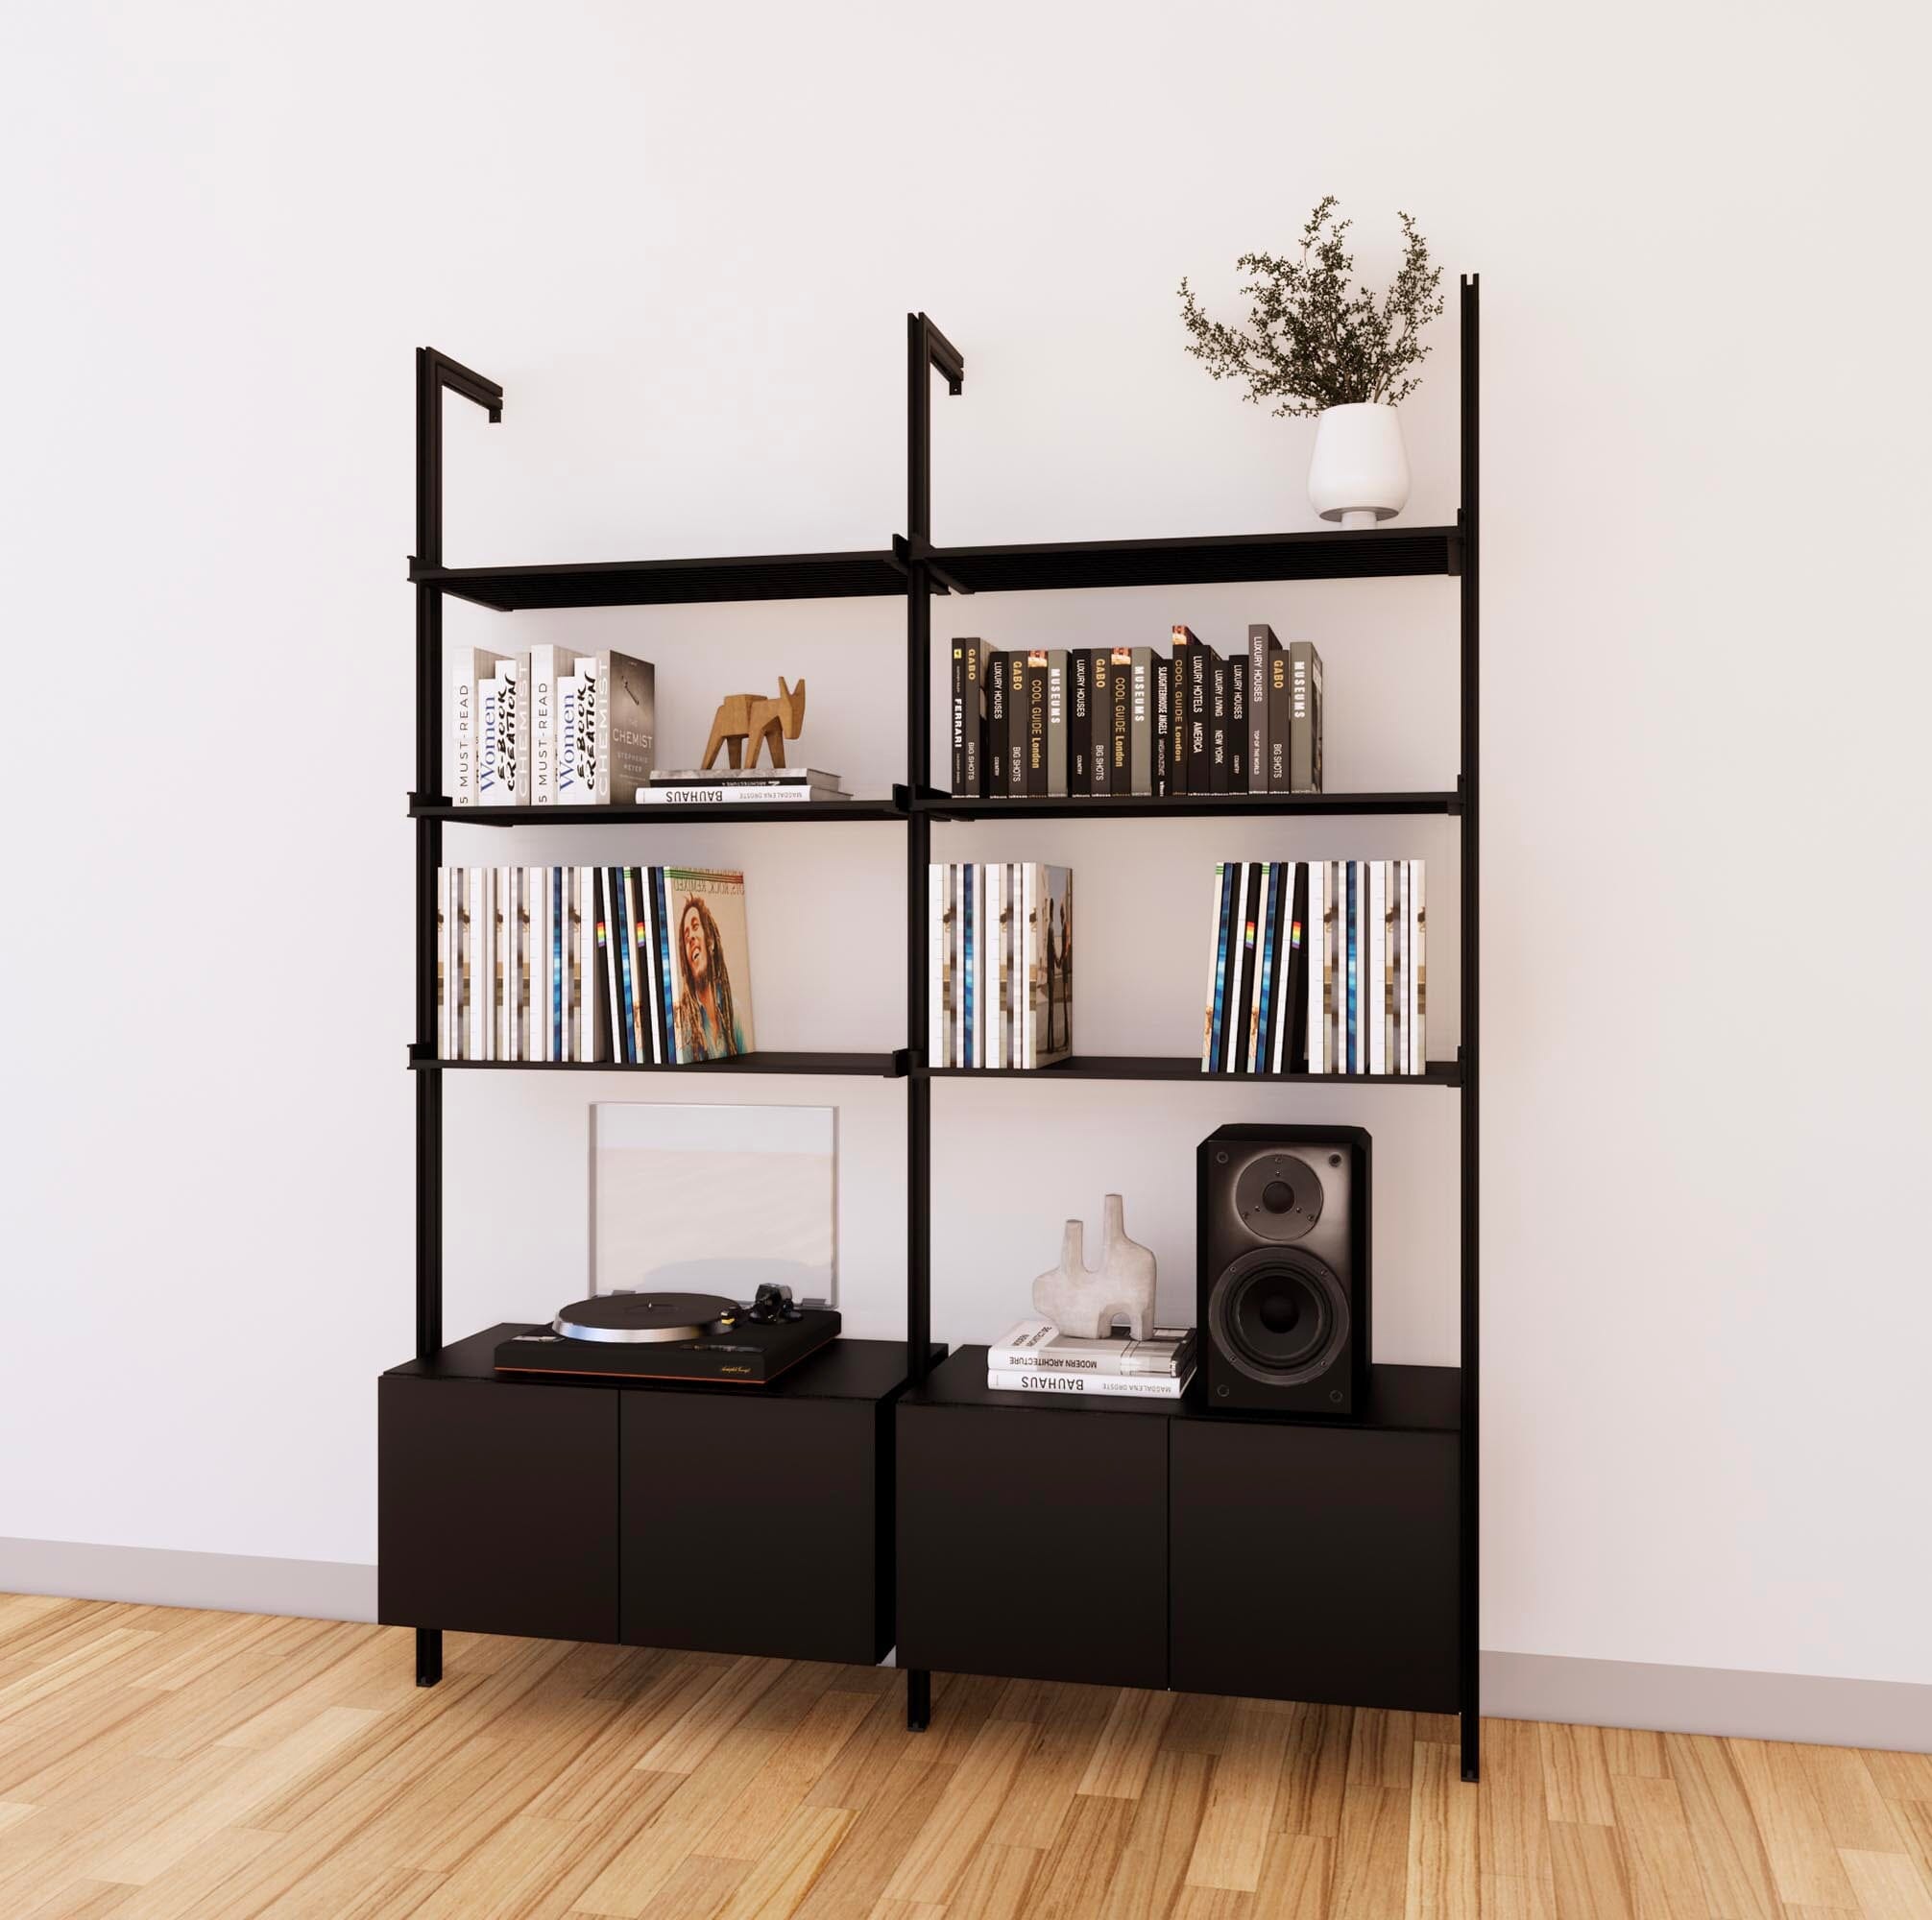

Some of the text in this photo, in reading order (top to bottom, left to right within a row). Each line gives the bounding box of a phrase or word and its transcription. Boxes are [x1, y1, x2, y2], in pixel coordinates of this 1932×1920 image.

[1013, 661, 1022, 690] GABO
[1051, 669, 1060, 724] MUSEUMS
[1096, 659, 1105, 688] GABO
[1135, 666, 1144, 722] MUSEUMS
[1159, 667, 1167, 713] SLAUGHTERHOUSE
[1234, 665, 1242, 720] LUXURY HOUSES
[1254, 636, 1262, 702] LUXURY HOUSES
[1274, 660, 1283, 688] GABO
[1295, 662, 1305, 718] MUSEUMS
[577, 684, 586, 778] E-BOOK
[1032, 679, 1041, 768] COOL GUIDE London
[1115, 677, 1125, 767] COOL GUIDE London
[1159, 715, 1167, 734] ANGELS
[1193, 656, 1202, 753] LUXURY HOTELS AMERICA
[460, 685, 468, 787] MUST-READ
[481, 697, 495, 792] Women
[497, 686, 507, 780] E-BOOK
[539, 683, 547, 785] MUST-READ
[560, 695, 574, 791] Women
[613, 729, 652, 748] CHEMIST
[1274, 744, 1282, 778] BIG SHOTS
[666, 790, 723, 802] BAUHAUS
[1009, 1357, 1097, 1368] MODERN ARCHITECTURE
[1021, 1376, 1084, 1390] BAUHAUS
